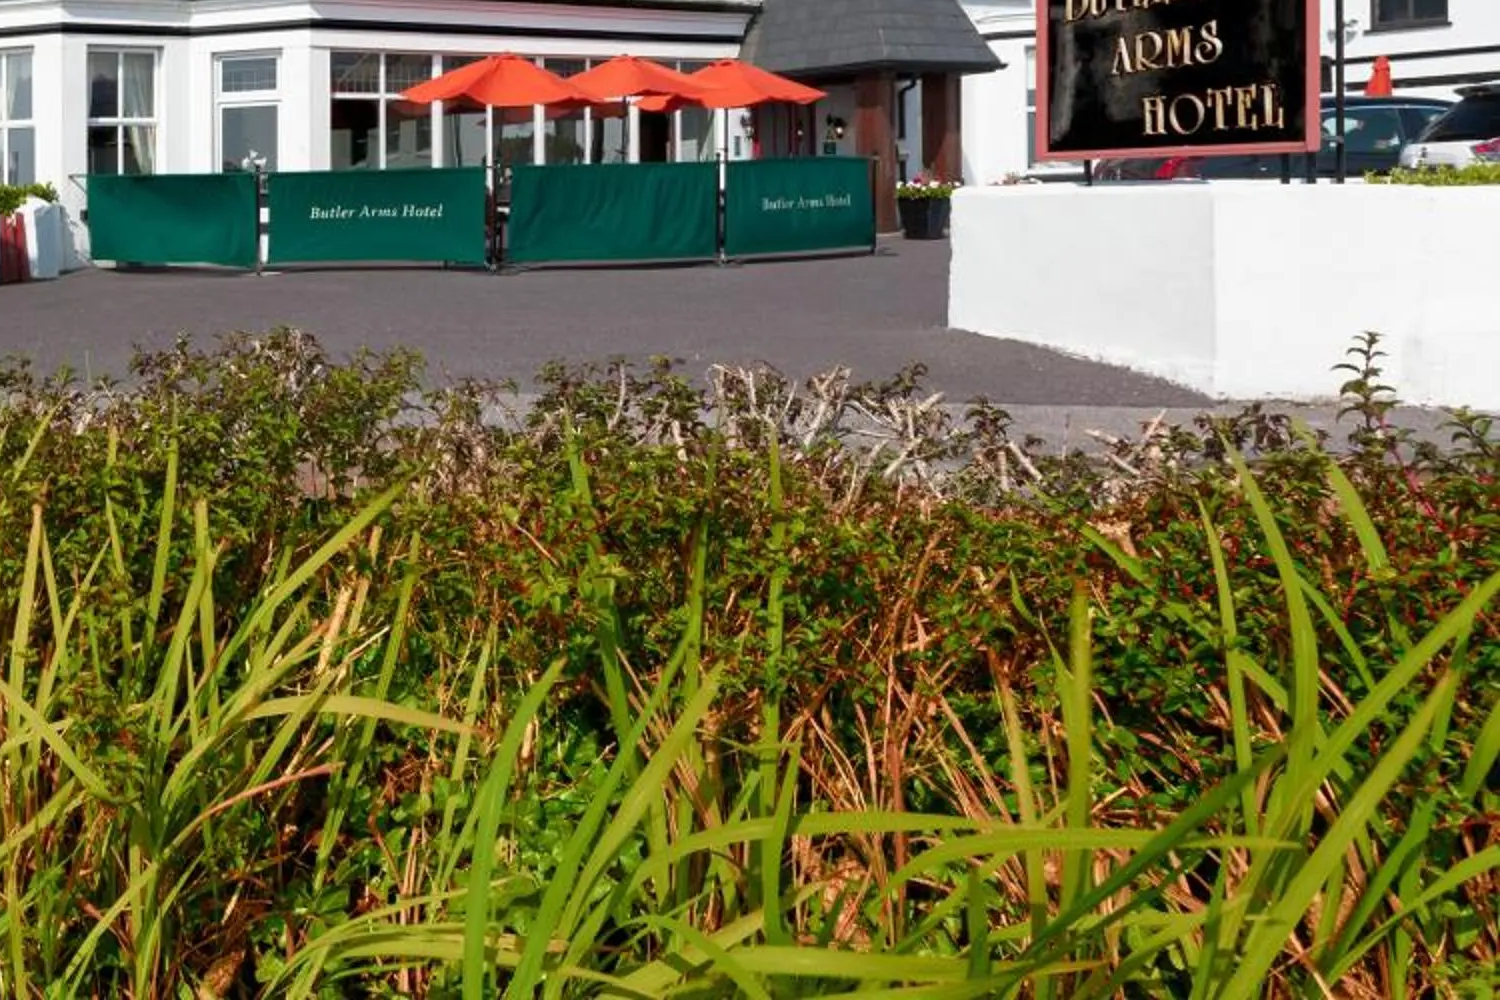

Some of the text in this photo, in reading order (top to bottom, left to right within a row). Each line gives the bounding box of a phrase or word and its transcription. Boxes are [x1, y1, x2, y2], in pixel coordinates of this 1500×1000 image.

[1111, 19, 1223, 75] ARMS
[1141, 82, 1285, 136] HOTEL
[309, 201, 444, 219] Butler Arms Hotel
[762, 193, 851, 211] Butler Arms Hotel
